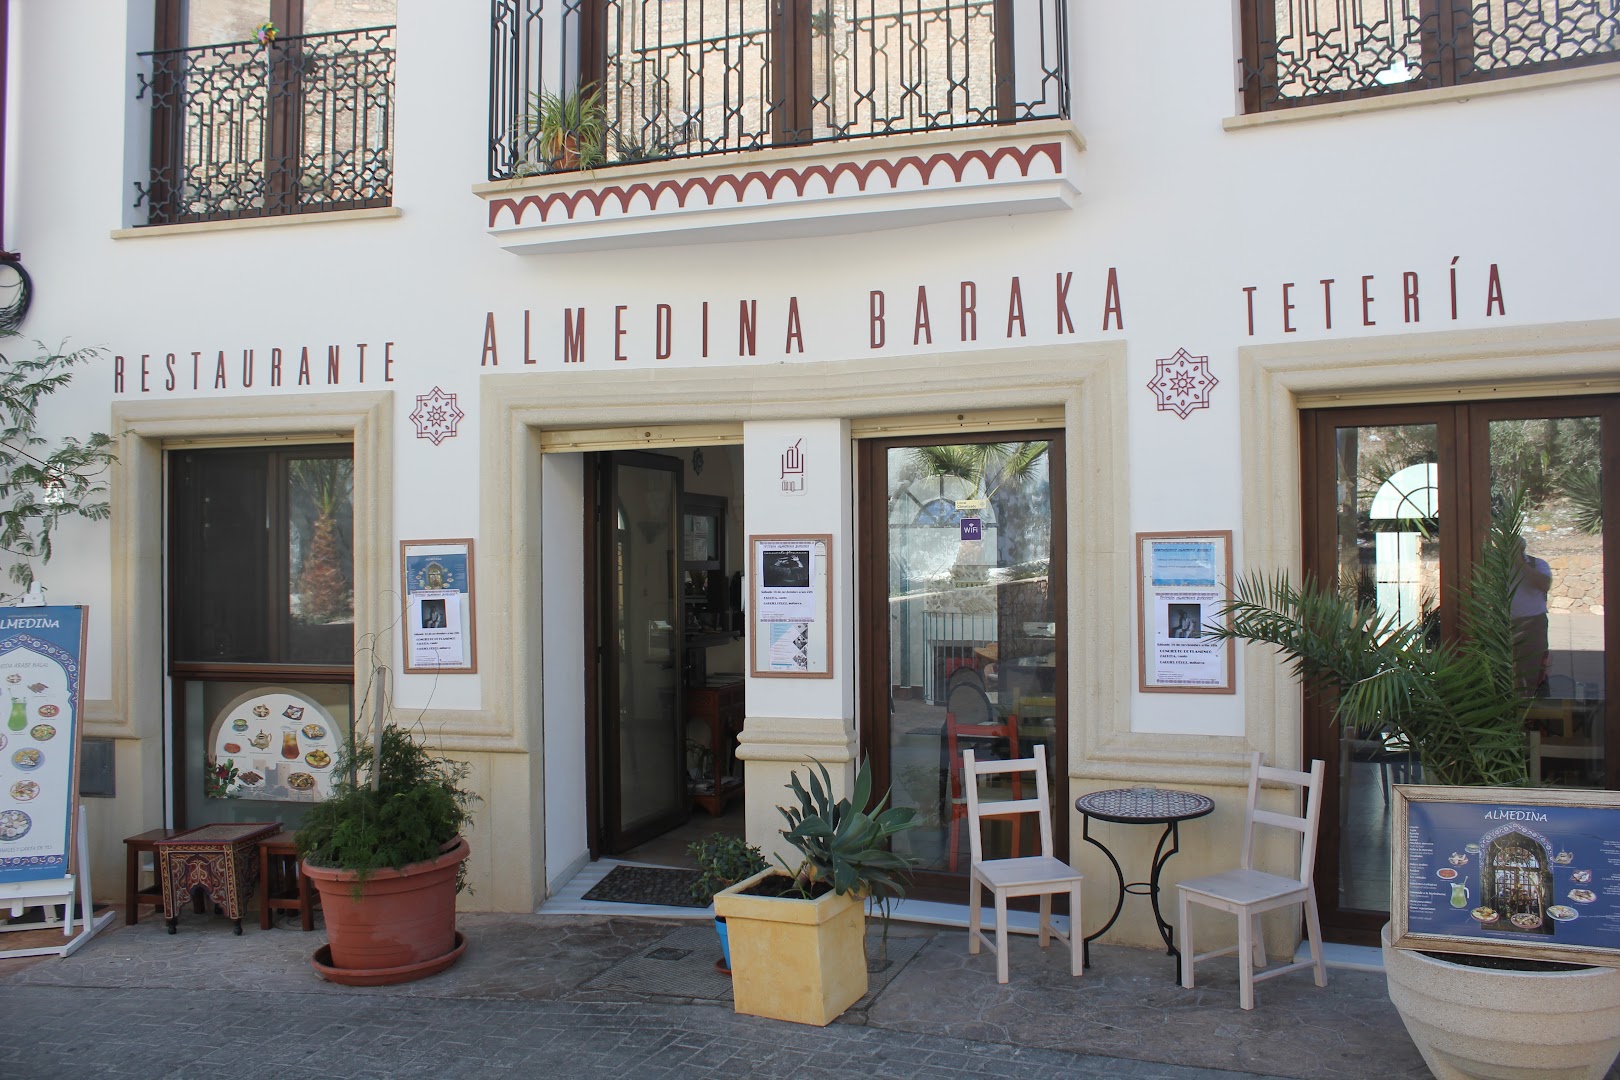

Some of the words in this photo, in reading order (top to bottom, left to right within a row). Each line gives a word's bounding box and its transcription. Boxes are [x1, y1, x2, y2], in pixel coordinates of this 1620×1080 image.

[481, 296, 804, 366] ALMEDINA
[869, 267, 1124, 349] BARAKA
[1242, 255, 1506, 337] TETERÍA
[114, 342, 394, 393] RESTAURANTE
[0, 618, 60, 630] LMEDINA
[1484, 809, 1548, 823] ALMEDINA
